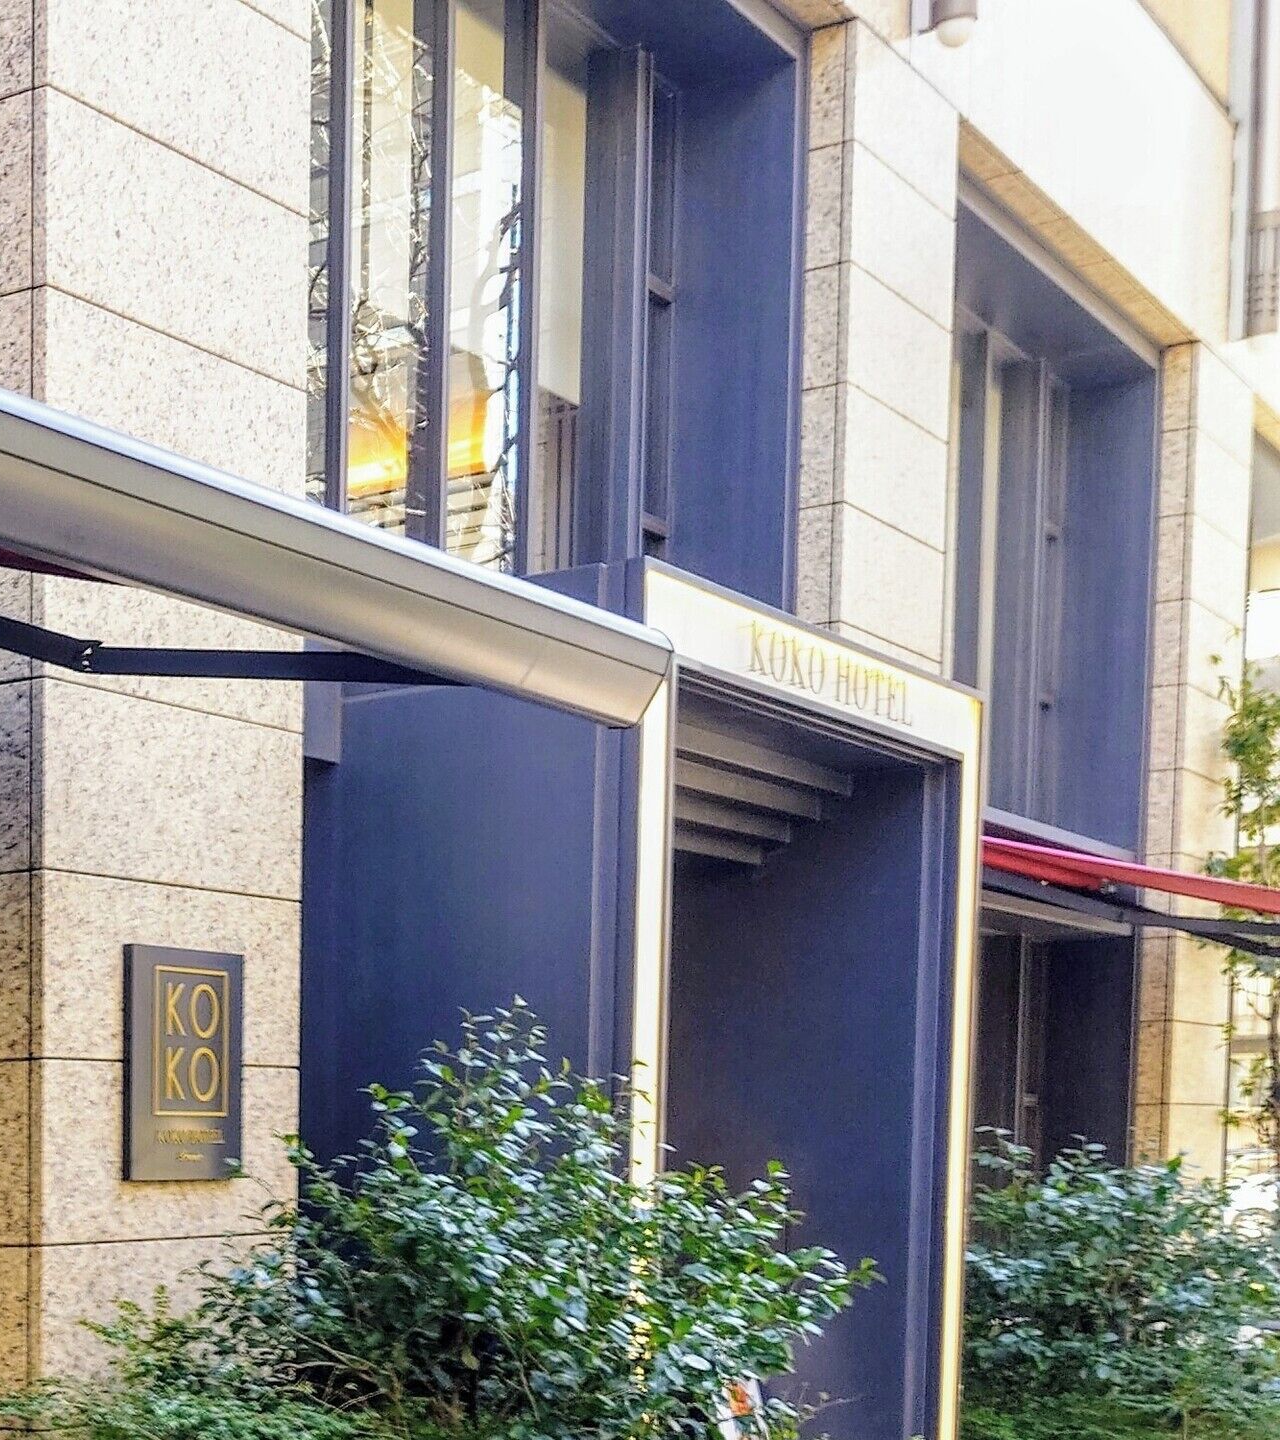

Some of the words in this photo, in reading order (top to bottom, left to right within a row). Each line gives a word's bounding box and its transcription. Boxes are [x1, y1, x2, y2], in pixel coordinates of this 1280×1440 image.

[748, 620, 825, 695] KOKO
[835, 654, 912, 727] HOTEL
[166, 982, 220, 1039] KO
[166, 1046, 220, 1102] KO
